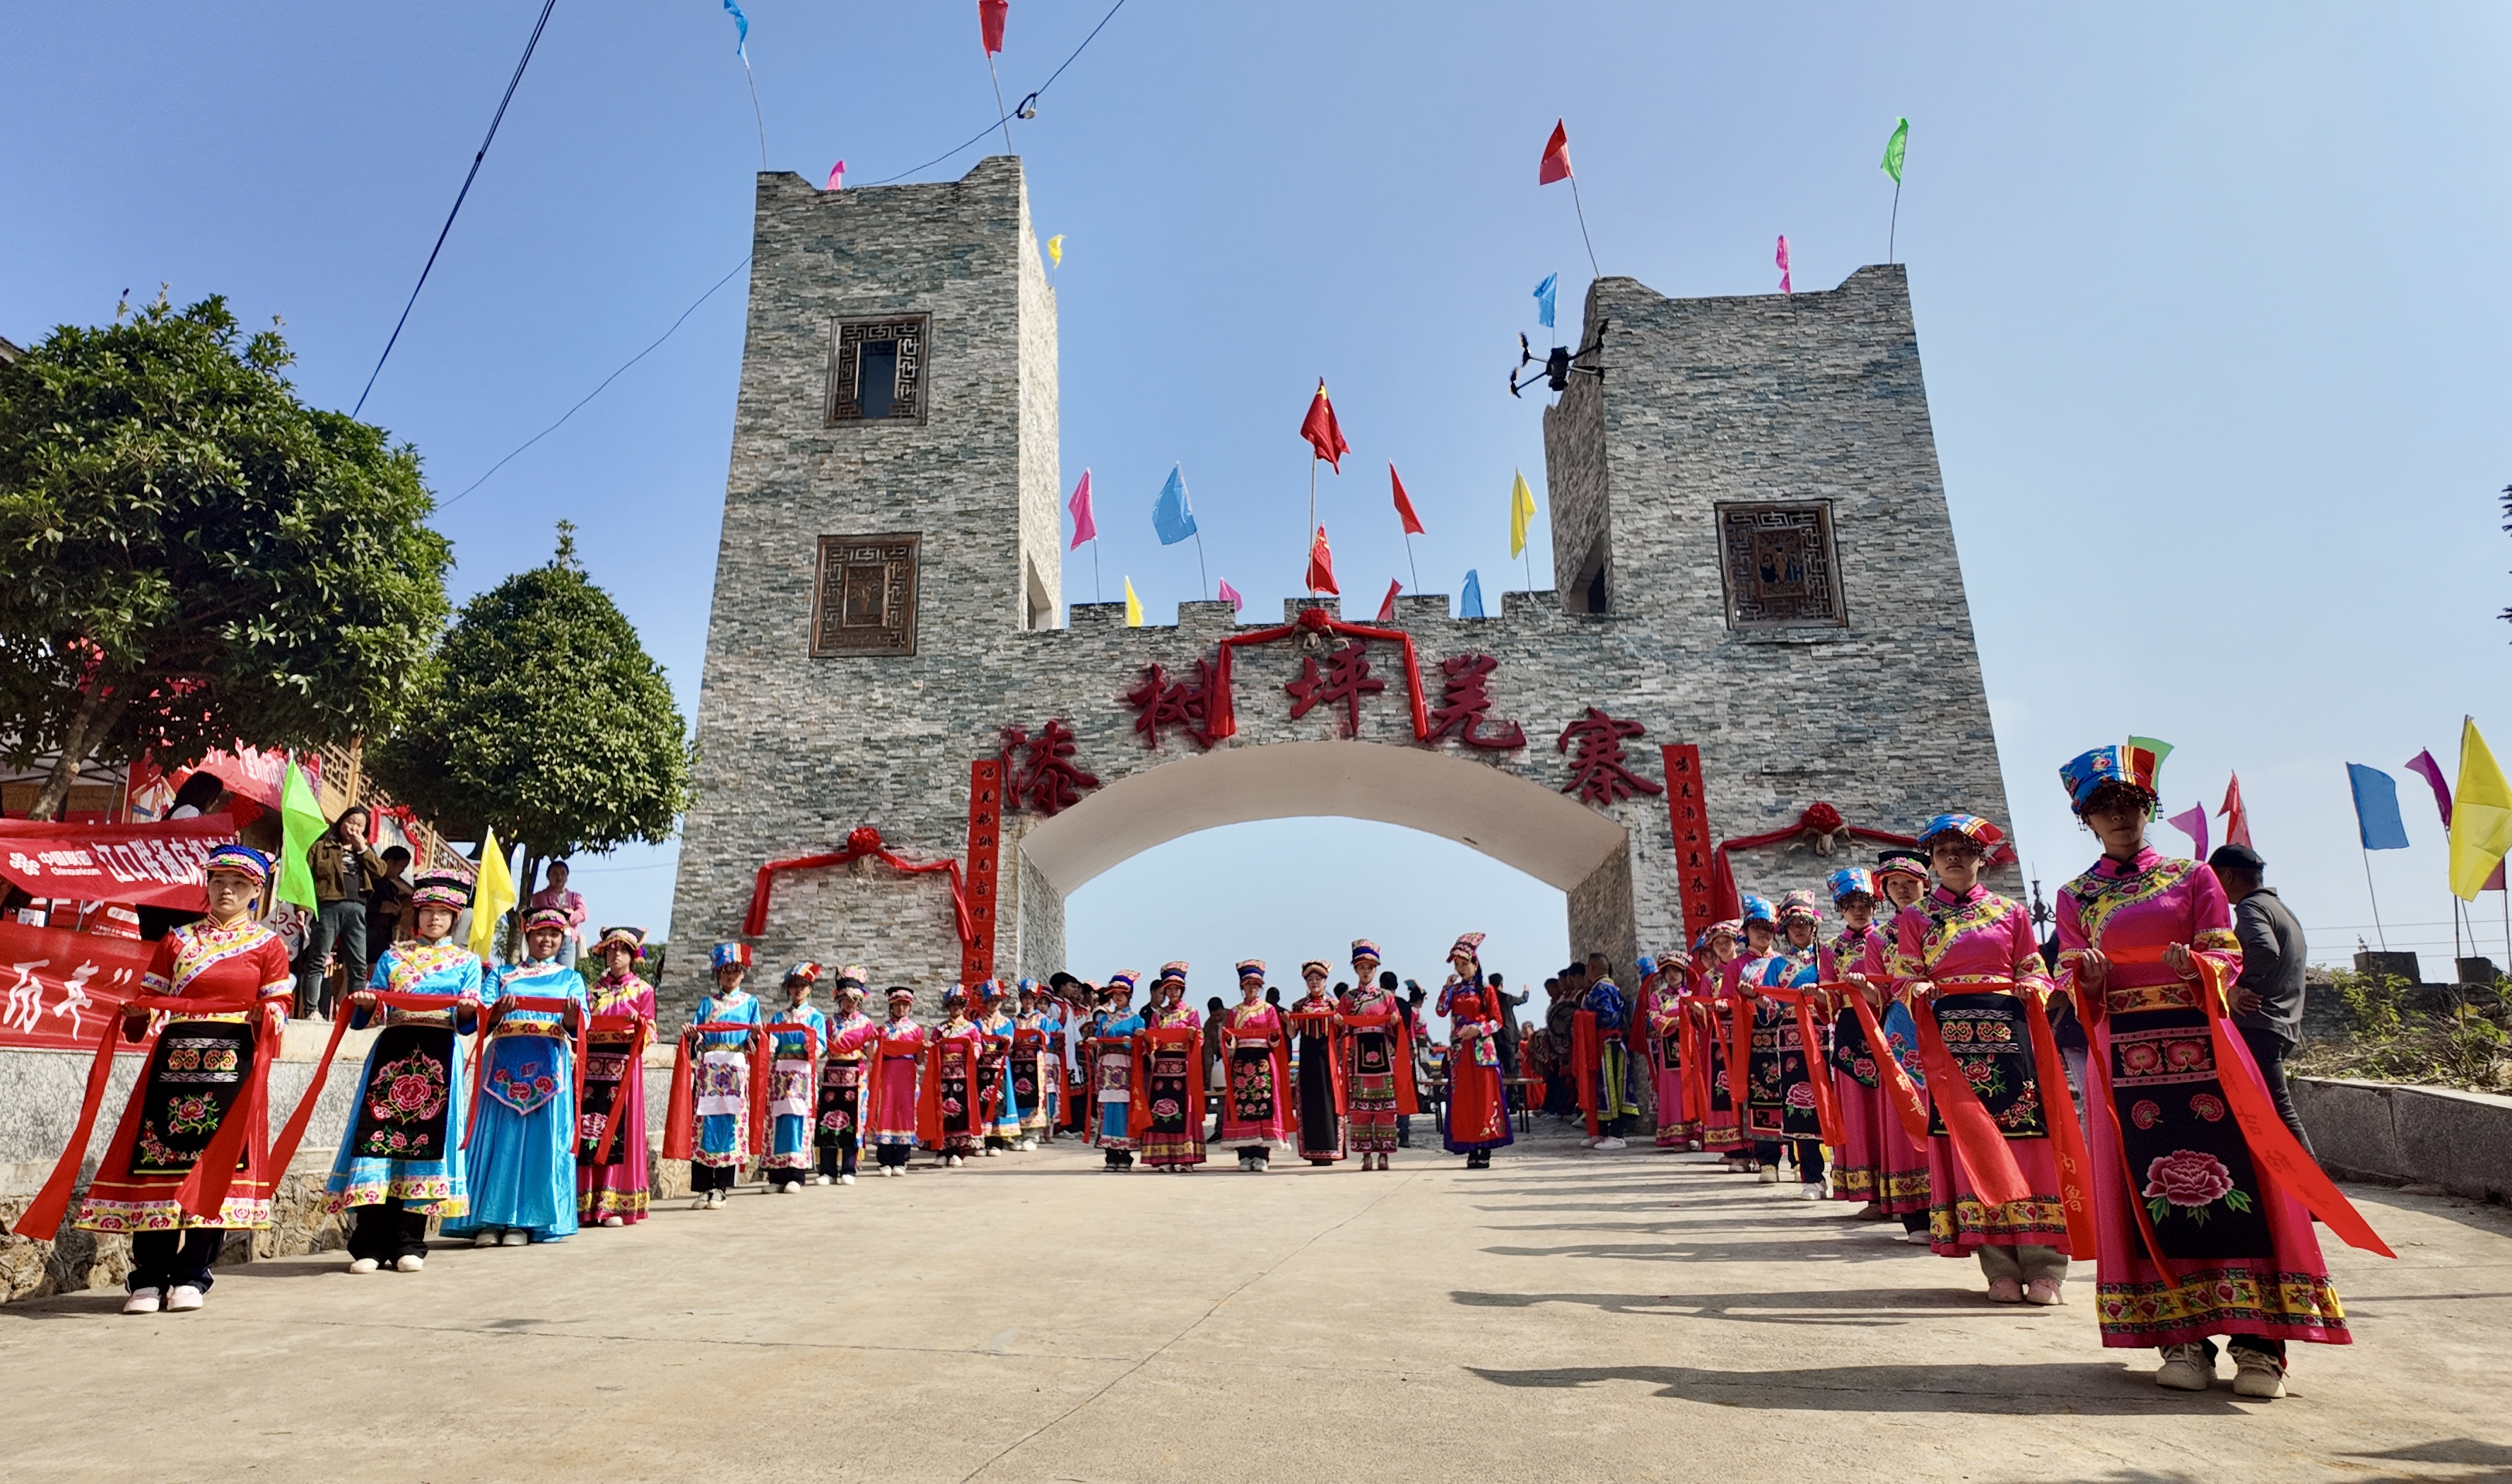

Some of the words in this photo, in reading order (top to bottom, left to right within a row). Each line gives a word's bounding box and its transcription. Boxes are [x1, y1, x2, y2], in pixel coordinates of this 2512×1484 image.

[1002, 643, 1665, 818] 漆树坪羌寨
[37, 850, 93, 866] 中国联通
[92, 836, 235, 888] 江口联通庆祝
